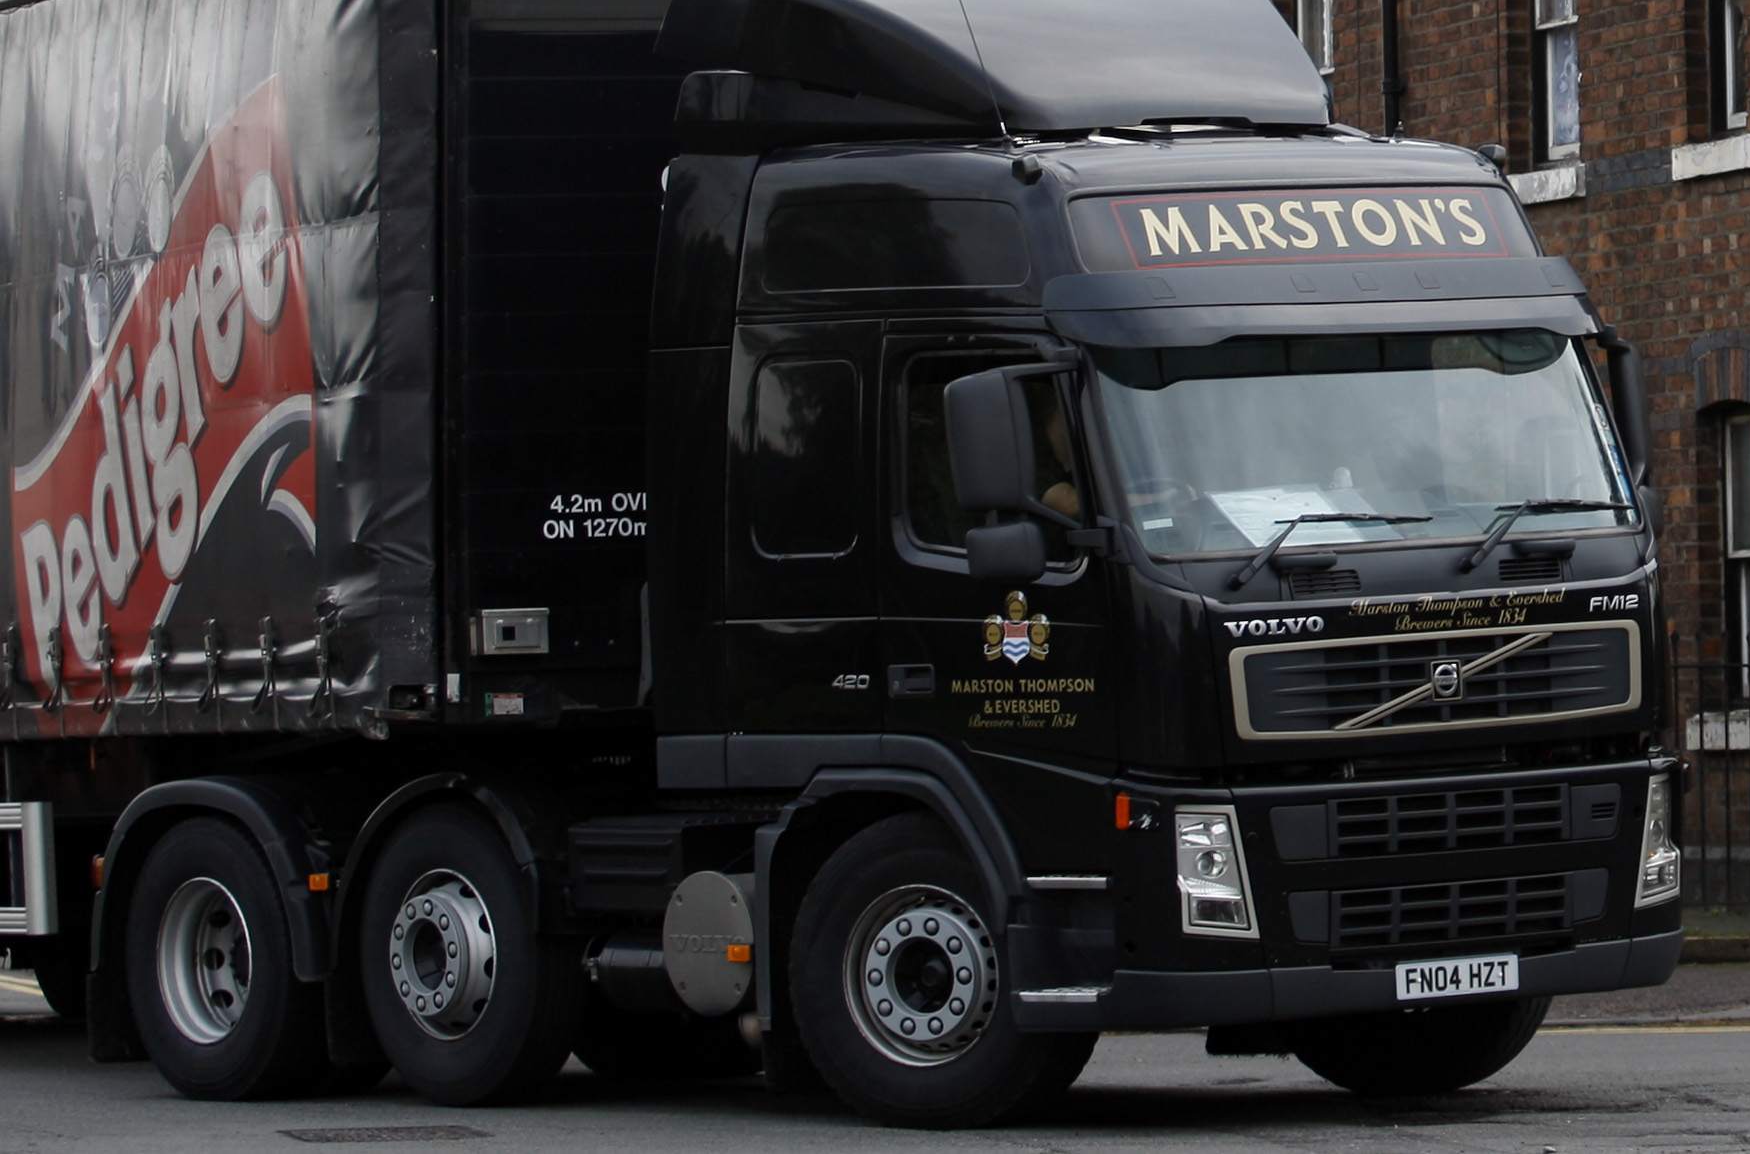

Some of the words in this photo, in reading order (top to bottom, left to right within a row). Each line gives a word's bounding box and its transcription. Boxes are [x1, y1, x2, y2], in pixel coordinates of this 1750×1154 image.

[1139, 198, 1486, 257] MARSTON'S
[20, 171, 289, 689] Pedigree
[550, 494, 602, 513] 4.2m
[611, 492, 647, 512] OV
[543, 519, 574, 539] ON
[1349, 599, 1409, 616] Marston
[1415, 596, 1483, 616] Thompson
[1489, 594, 1501, 607] &
[1506, 587, 1566, 607] Evershed
[1589, 593, 1639, 612] FM12
[1224, 615, 1324, 638] VOLVO
[1395, 614, 1453, 631] Brewers
[1456, 611, 1491, 628] Since
[1498, 607, 1527, 624] 1834
[832, 674, 871, 689] 420
[951, 678, 1014, 693] MARSTON
[1019, 677, 1096, 693] THOMPSON
[1405, 964, 1462, 994] FN04
[1469, 961, 1509, 989] HZT
